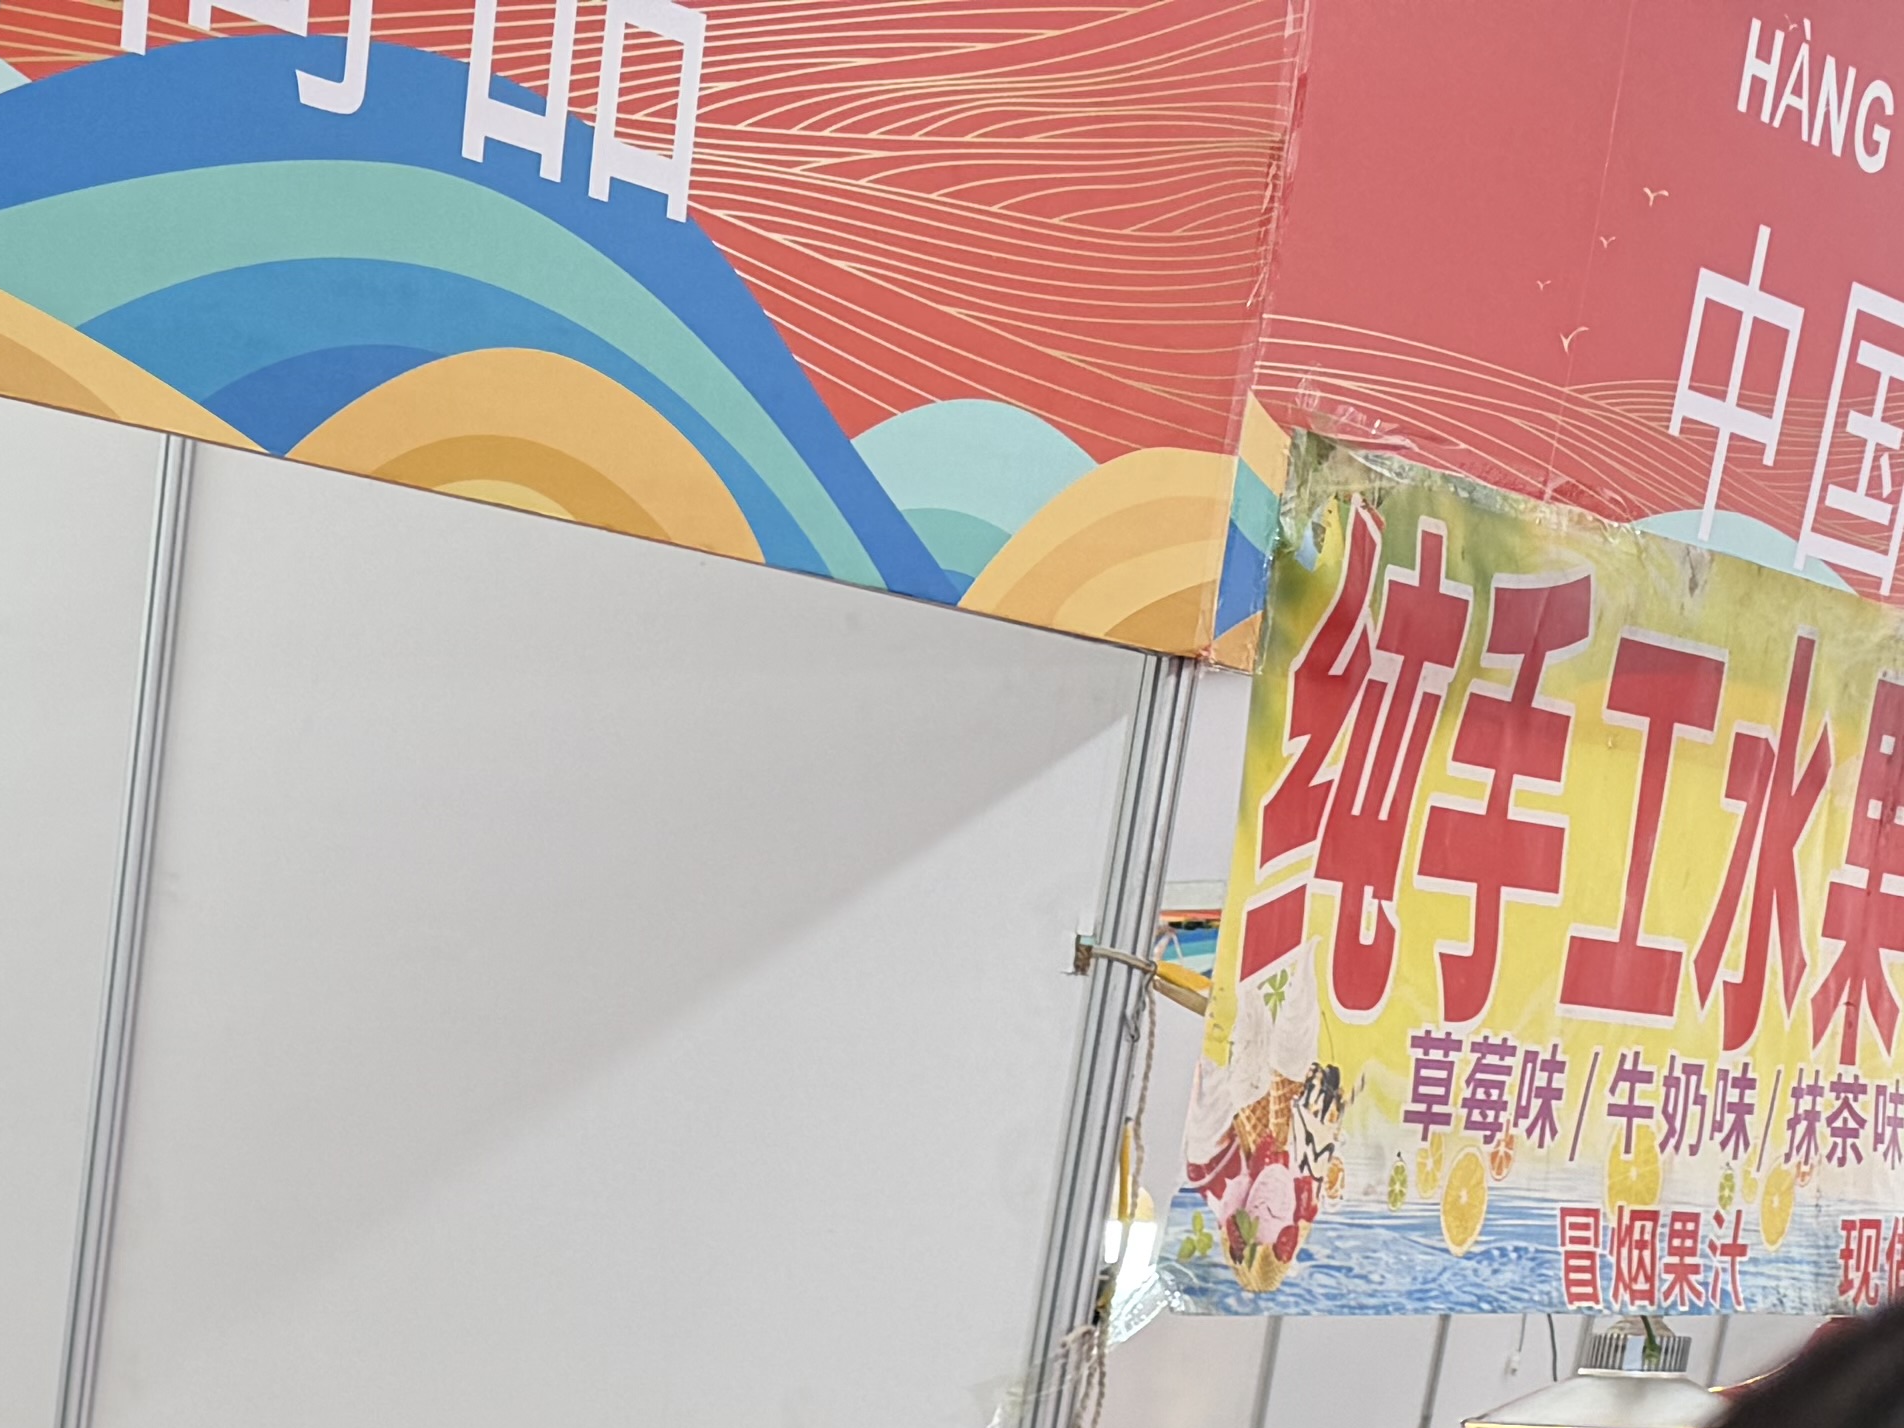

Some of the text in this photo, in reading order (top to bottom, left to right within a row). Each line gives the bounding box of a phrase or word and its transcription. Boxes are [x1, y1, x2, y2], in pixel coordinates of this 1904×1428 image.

[1737, 17, 1895, 174] HÀNG
[1558, 1203, 1750, 1311] 冒烟果汁
